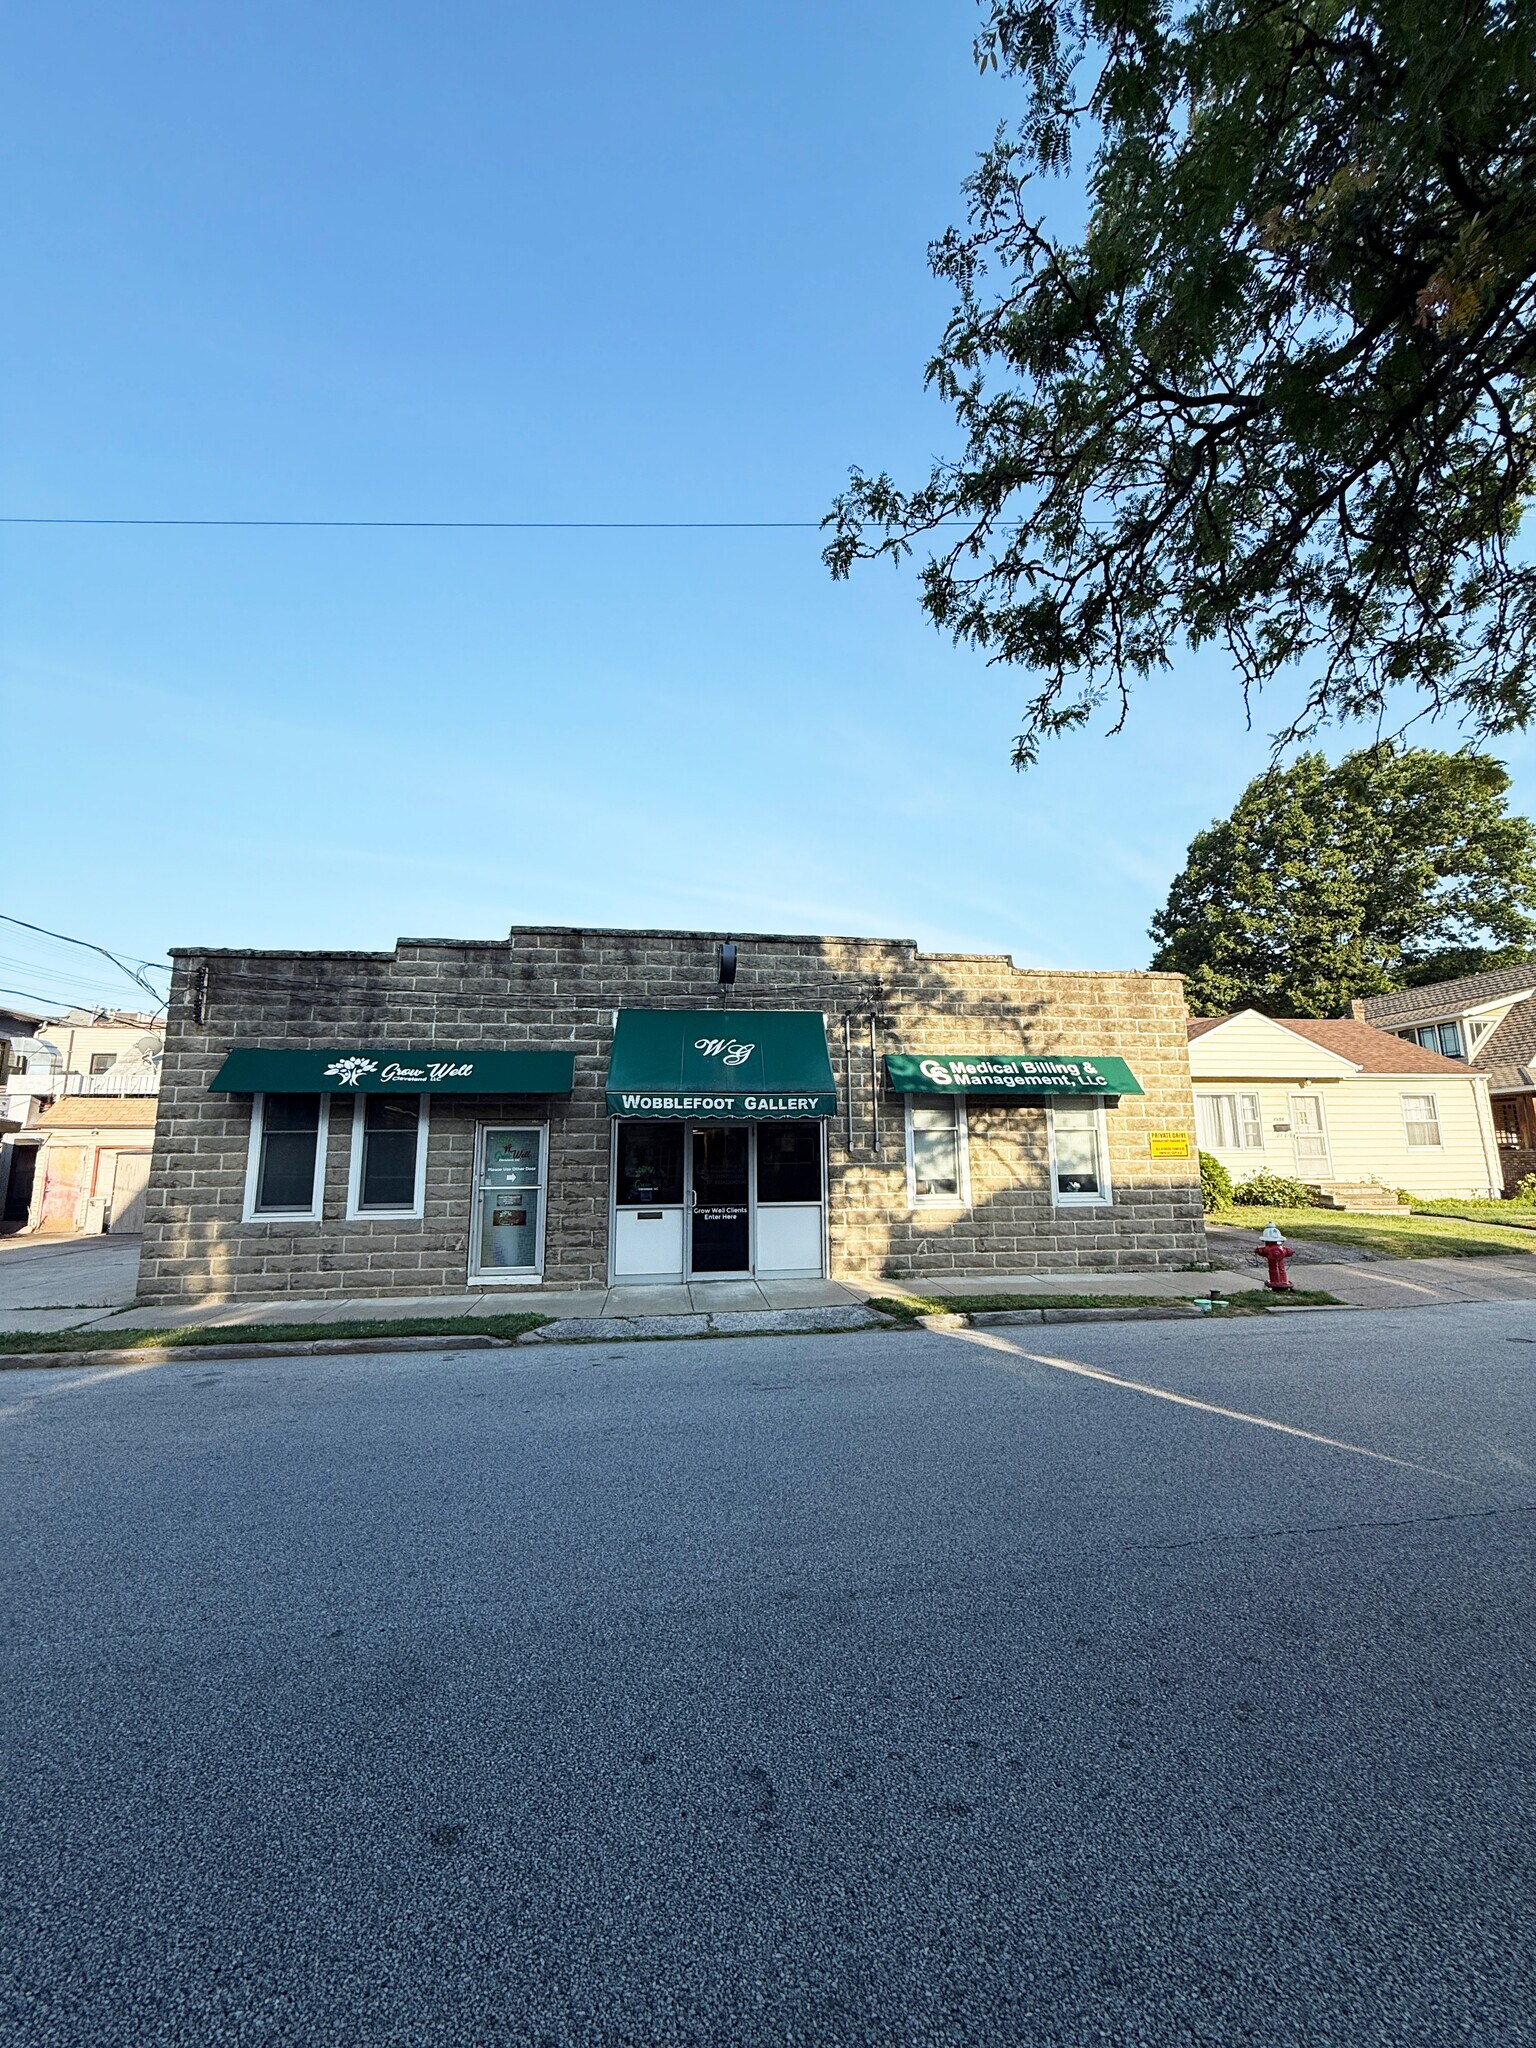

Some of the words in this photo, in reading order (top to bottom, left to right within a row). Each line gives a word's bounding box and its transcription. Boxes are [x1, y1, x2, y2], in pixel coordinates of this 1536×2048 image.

[380, 1063, 425, 1082] Grow
[426, 1063, 474, 1079] Well
[949, 1061, 1019, 1075] Medical
[1021, 1062, 1081, 1076] Billing
[1083, 1061, 1098, 1074] &
[954, 1074, 1077, 1087] Management,
[1078, 1076, 1108, 1086] LLC
[622, 1094, 735, 1110] WOBBLEFOOT
[744, 1096, 819, 1110] GALLERY
